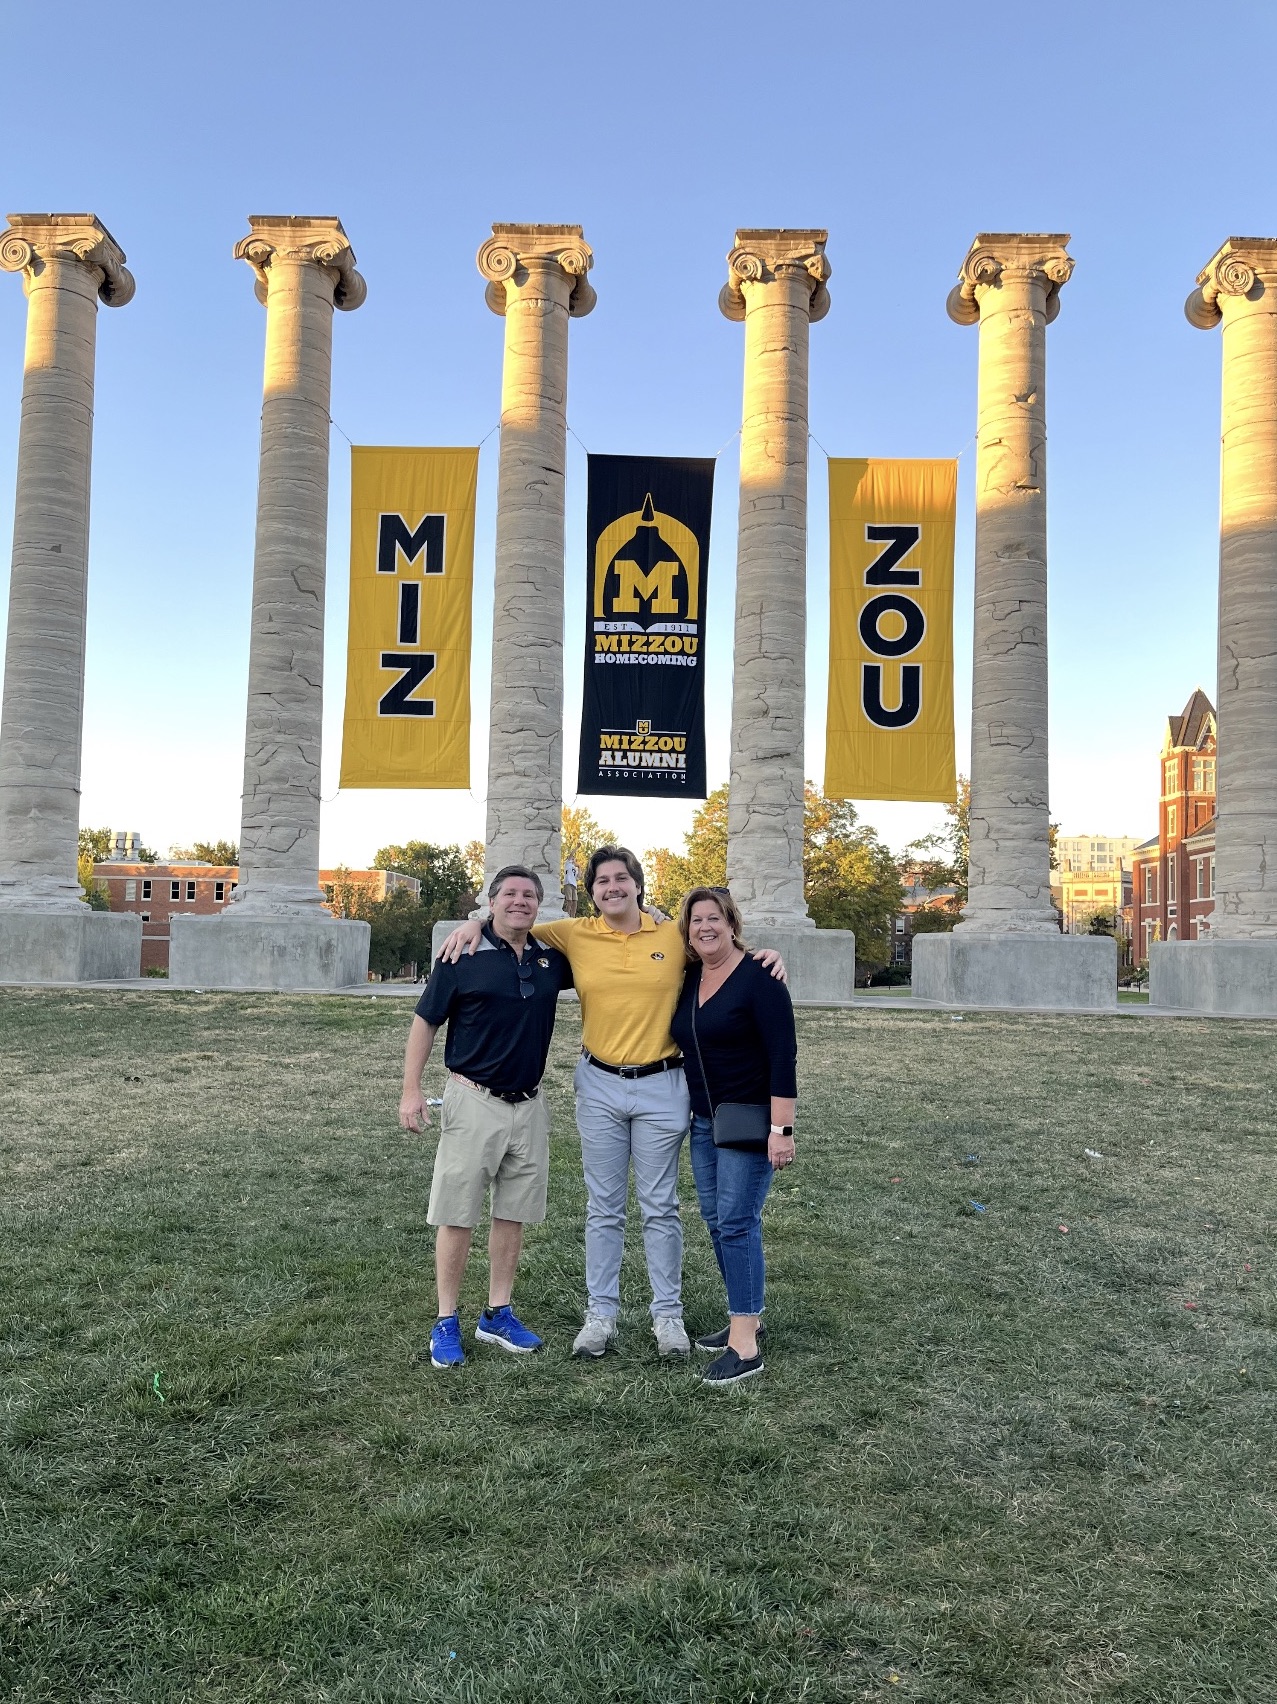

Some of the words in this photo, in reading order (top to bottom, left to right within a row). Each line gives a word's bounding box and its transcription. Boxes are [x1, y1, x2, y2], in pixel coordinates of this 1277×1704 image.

[376, 512, 447, 719] MIZ
[604, 623, 633, 631] EST.
[664, 624, 690, 632] 1911
[857, 522, 928, 730] ZOU
[594, 634, 699, 654] MIZZOU
[594, 653, 697, 666] HOMECOMING
[600, 734, 686, 751] MIZZOU
[598, 751, 686, 768] ALUMNI
[598, 770, 686, 780] ASSOCIATION
